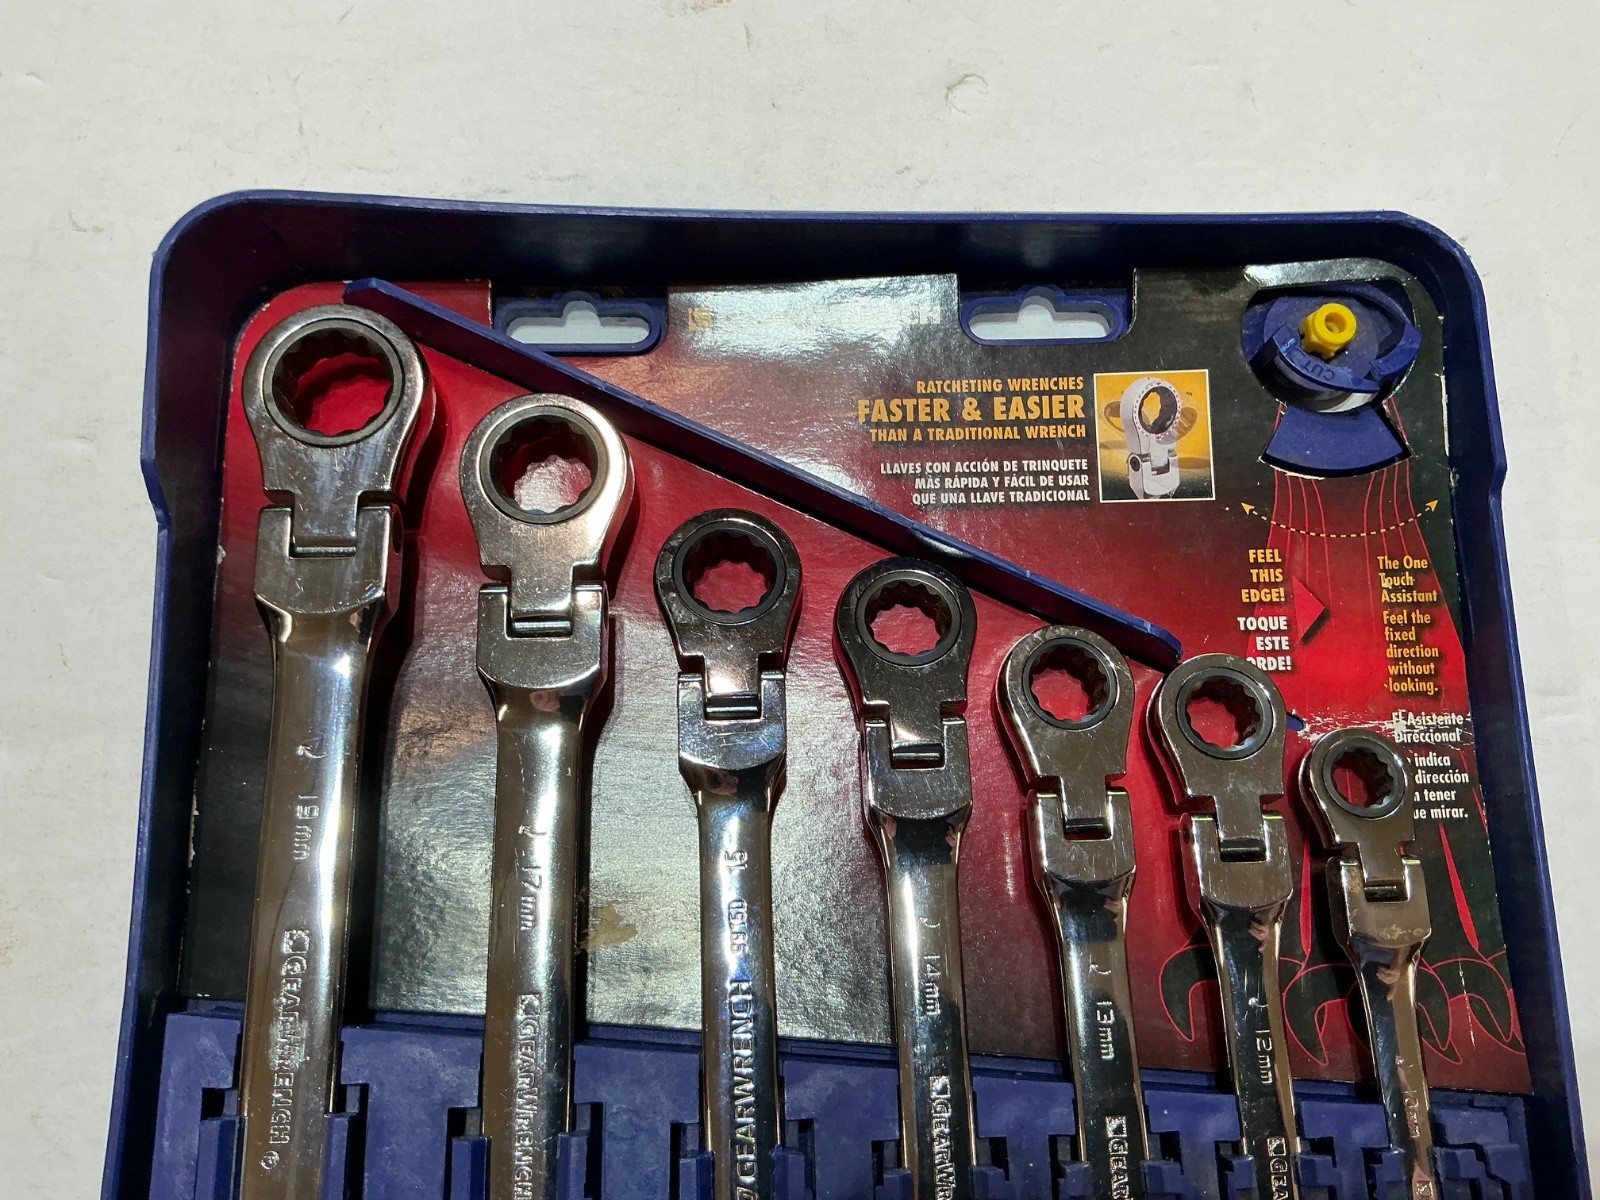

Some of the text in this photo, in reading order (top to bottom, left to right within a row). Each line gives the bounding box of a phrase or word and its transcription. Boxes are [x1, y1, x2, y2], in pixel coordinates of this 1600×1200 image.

[916, 376, 1084, 394] RATCHETING WRENCHES
[858, 394, 1085, 423] FASTER & EASIER
[869, 425, 1086, 442] THAN A TRADITIONAL WRENCH
[880, 458, 1088, 475] LLAVES CON ACCIÓN DE TRINQUETE
[944, 474, 988, 489] RÁPIDA
[992, 475, 1000, 488] Y
[1004, 472, 1035, 488] FÁCIL
[1039, 475, 1055, 487] DE
[1058, 474, 1089, 486] USAR
[912, 489, 1090, 505] QUE UNA LLAVE TRADICIONAL
[1248, 549, 1282, 563] FEEL
[1377, 555, 1428, 570] The One
[1250, 568, 1283, 583] THIS
[1379, 572, 1414, 586] Touch
[1241, 587, 1285, 602] EDGE!
[1382, 589, 1438, 603] Assistant
[1237, 616, 1288, 631] TOQUE
[1383, 609, 1431, 624] Feel the
[1385, 626, 1416, 641] fixed
[1256, 636, 1290, 651] ESTE
[1386, 644, 1439, 658] direction
[1246, 656, 1292, 671] ORDE!
[1388, 660, 1435, 675] without
[1389, 677, 1438, 695] looking.
[1407, 712, 1464, 725] Asistente
[1394, 728, 1461, 743] Direccional
[1414, 752, 1451, 767] indica
[1415, 769, 1470, 784] dirección
[1423, 789, 1456, 801] tener
[1414, 805, 1469, 819] ue mirar.
[1097, 1001, 1115, 1060] 13mm
[1254, 1029, 1273, 1085] 12mm
[729, 979, 756, 1179] GEARWRENCH
[931, 1098, 957, 1200] GEARWR
